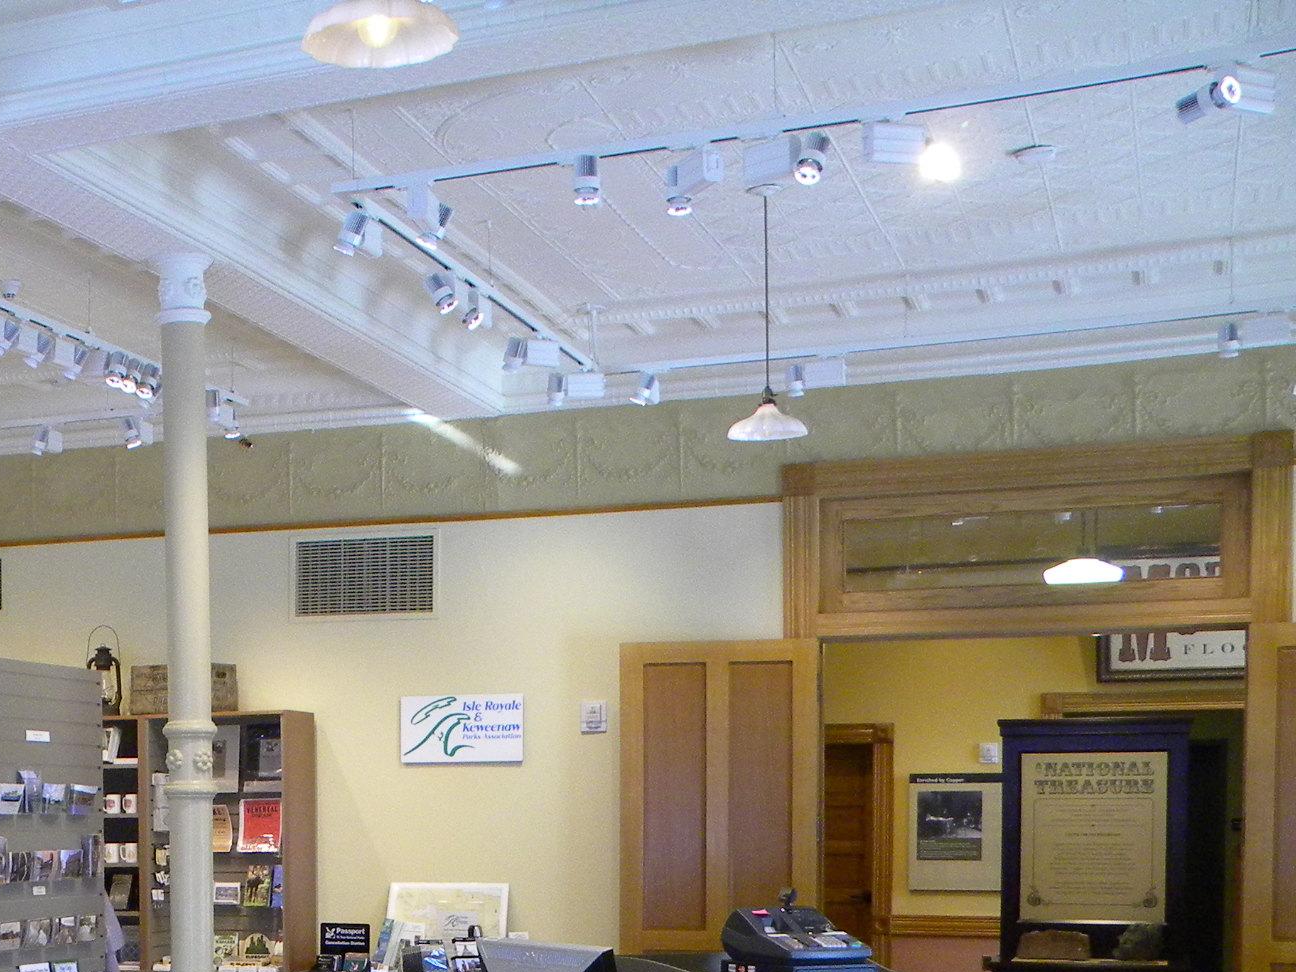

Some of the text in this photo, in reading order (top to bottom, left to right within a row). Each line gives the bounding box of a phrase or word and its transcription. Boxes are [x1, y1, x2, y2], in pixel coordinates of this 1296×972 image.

[462, 700, 522, 714] Isle Royale
[474, 712, 483, 722] &
[462, 723, 520, 733] Keweenaw
[1043, 761, 1155, 777] NATIONAL
[1034, 778, 1155, 795] TREASURE
[336, 927, 365, 935] Passport
